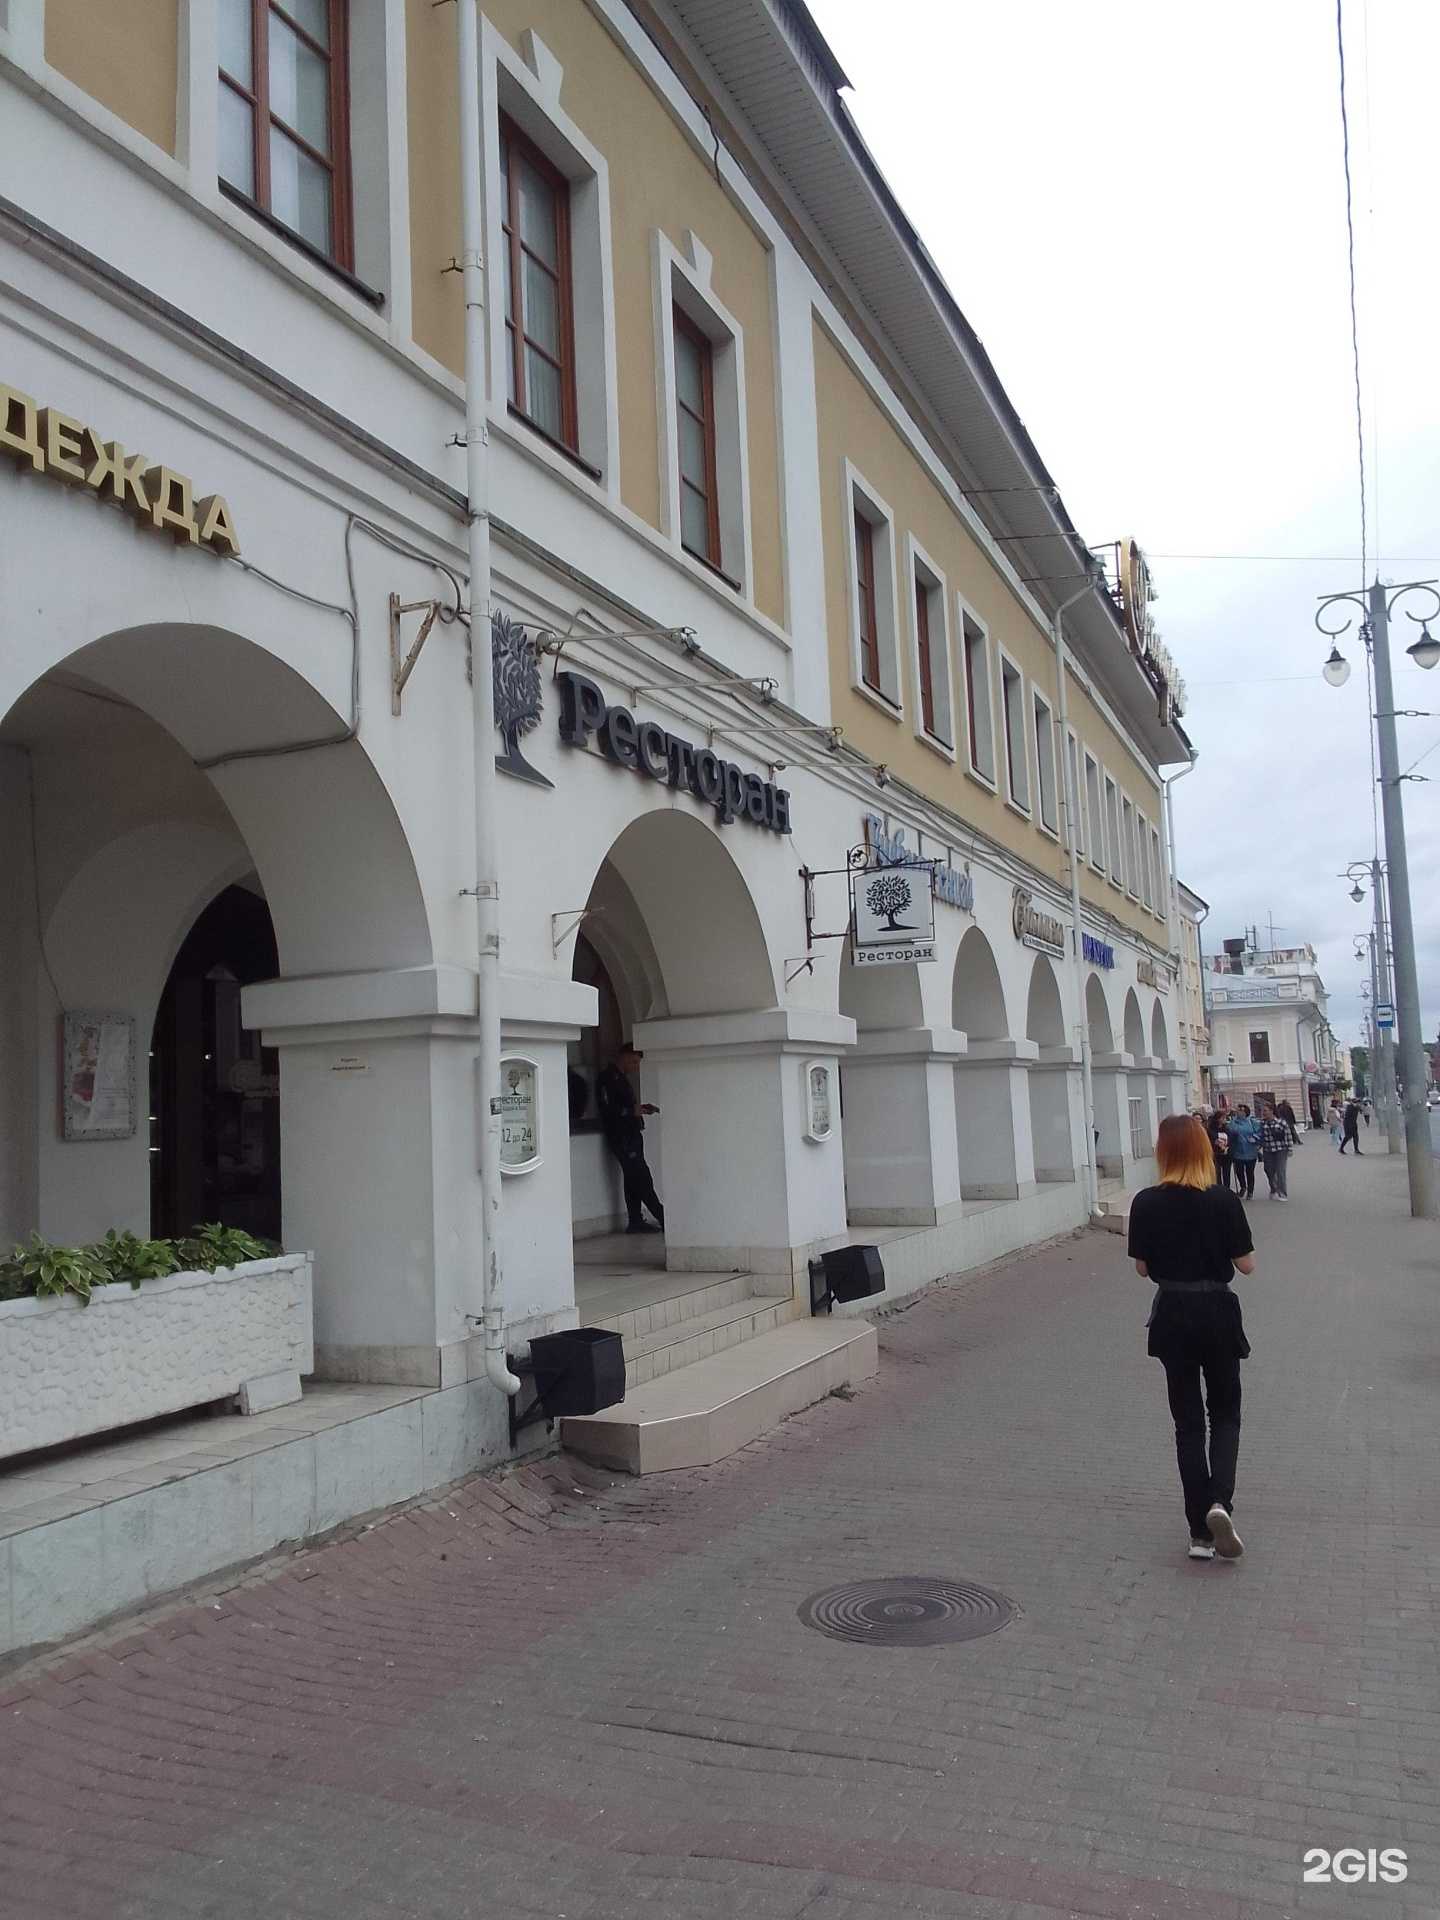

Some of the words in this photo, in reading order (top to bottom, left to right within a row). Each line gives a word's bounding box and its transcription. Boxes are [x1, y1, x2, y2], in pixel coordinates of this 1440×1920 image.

[558, 671, 792, 835] Ресторан
[858, 948, 933, 962] Ресторан
[501, 1096, 532, 1105] есторан
